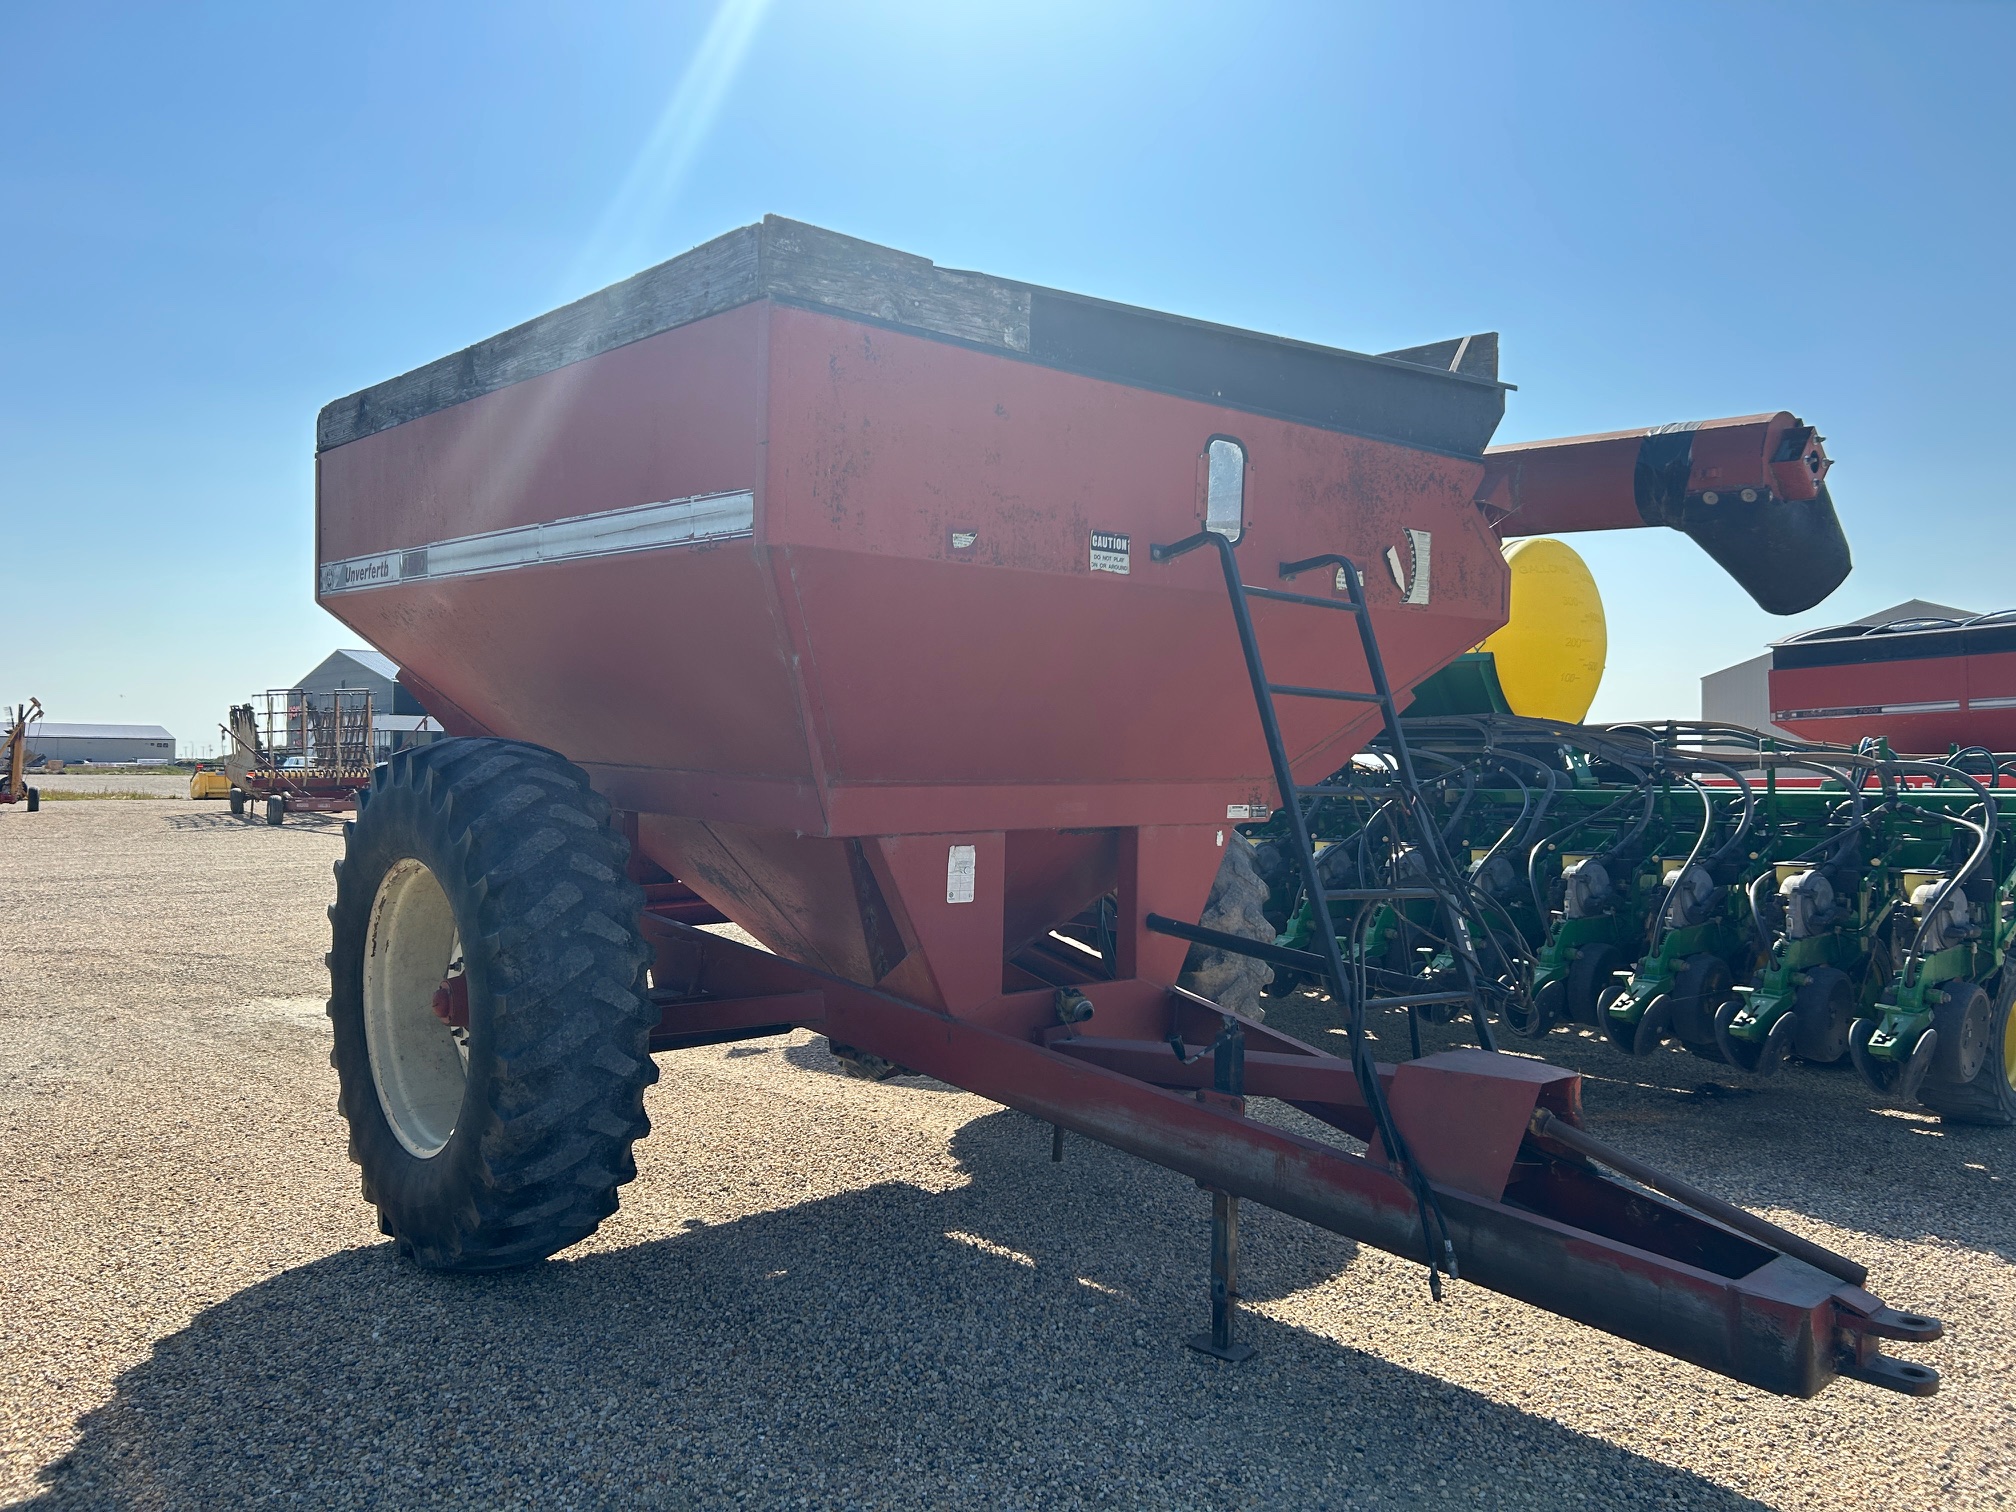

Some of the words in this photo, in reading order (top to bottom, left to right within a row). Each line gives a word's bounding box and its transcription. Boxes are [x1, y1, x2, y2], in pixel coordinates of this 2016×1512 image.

[1092, 535, 1127, 551] CAUTION
[345, 560, 389, 583] Unverferth
[1565, 637, 1582, 648] 200
